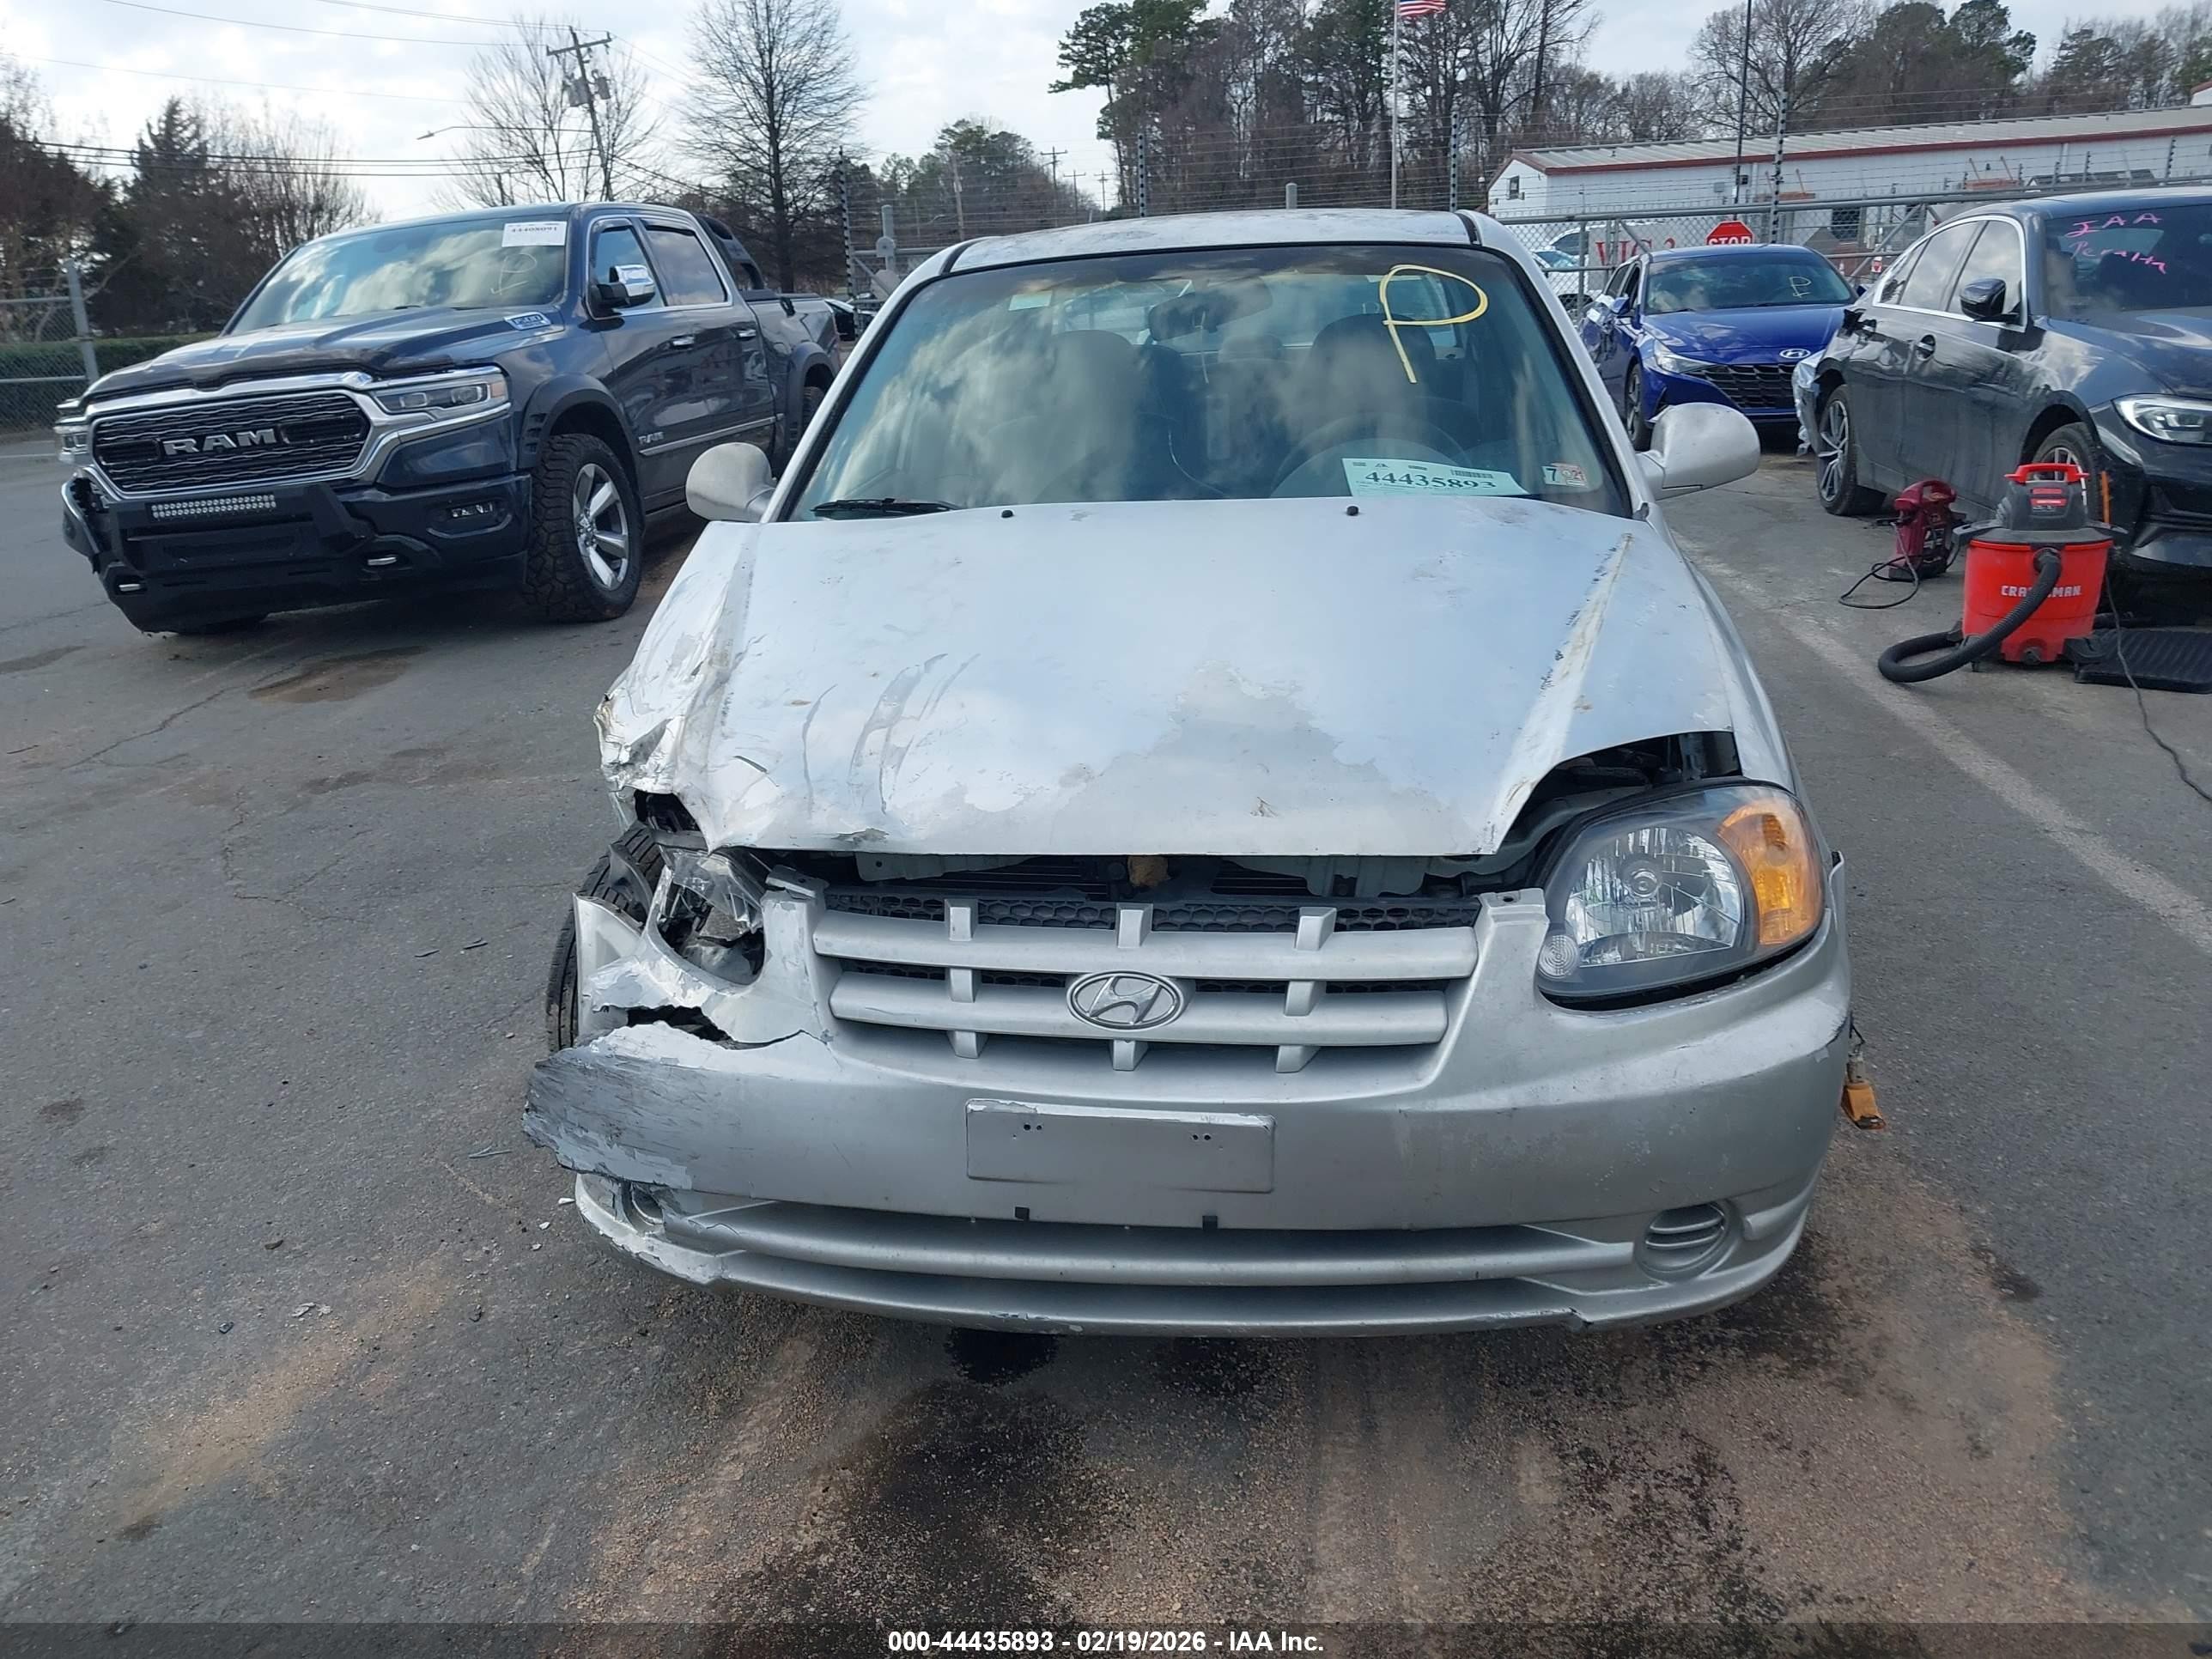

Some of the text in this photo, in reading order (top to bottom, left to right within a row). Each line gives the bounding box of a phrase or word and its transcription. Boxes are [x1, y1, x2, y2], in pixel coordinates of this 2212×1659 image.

[2064, 213, 2162, 238] IAA
[1379, 264, 1489, 383] P
[162, 428, 276, 455] RAM
[1364, 471, 1496, 489] 44435893
[2001, 585, 2081, 599] CRAMAN
